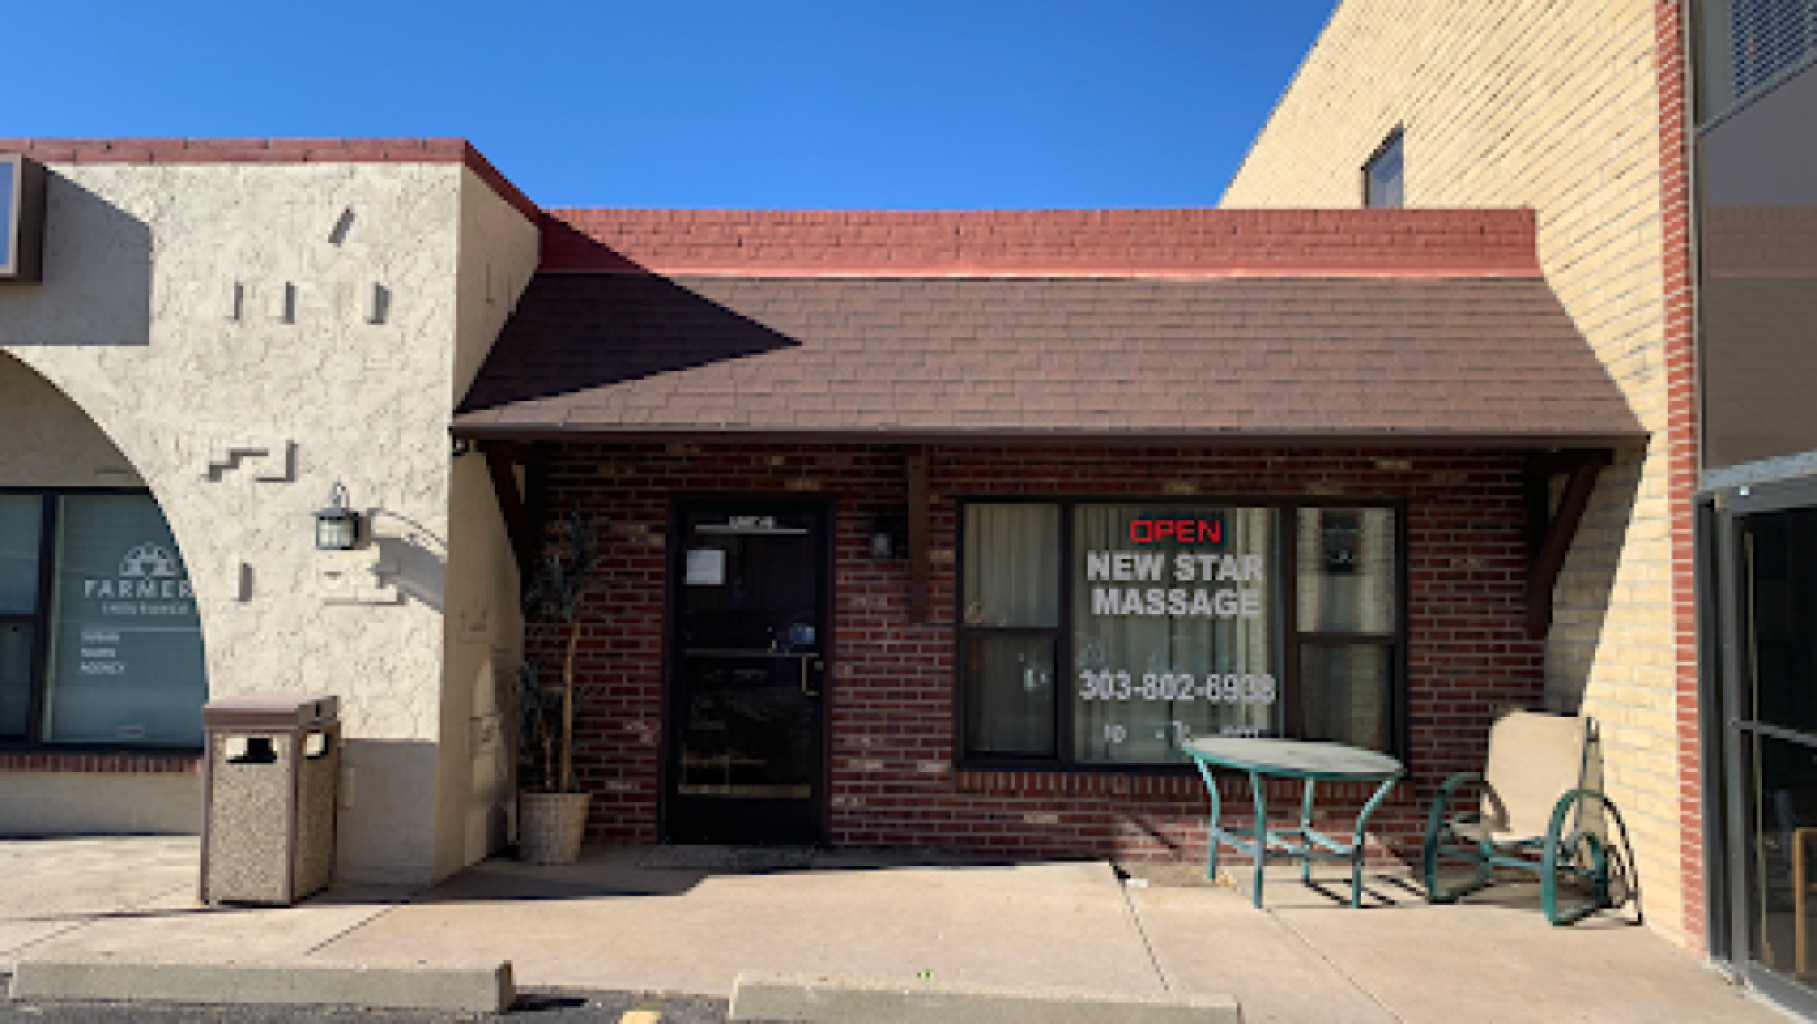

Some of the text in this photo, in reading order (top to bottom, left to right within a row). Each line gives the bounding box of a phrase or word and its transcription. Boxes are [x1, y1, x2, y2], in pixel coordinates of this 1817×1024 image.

[1129, 519, 1222, 543] OPEN
[1087, 551, 1264, 581] NEW STAR
[1090, 588, 1260, 617] MASSAGE
